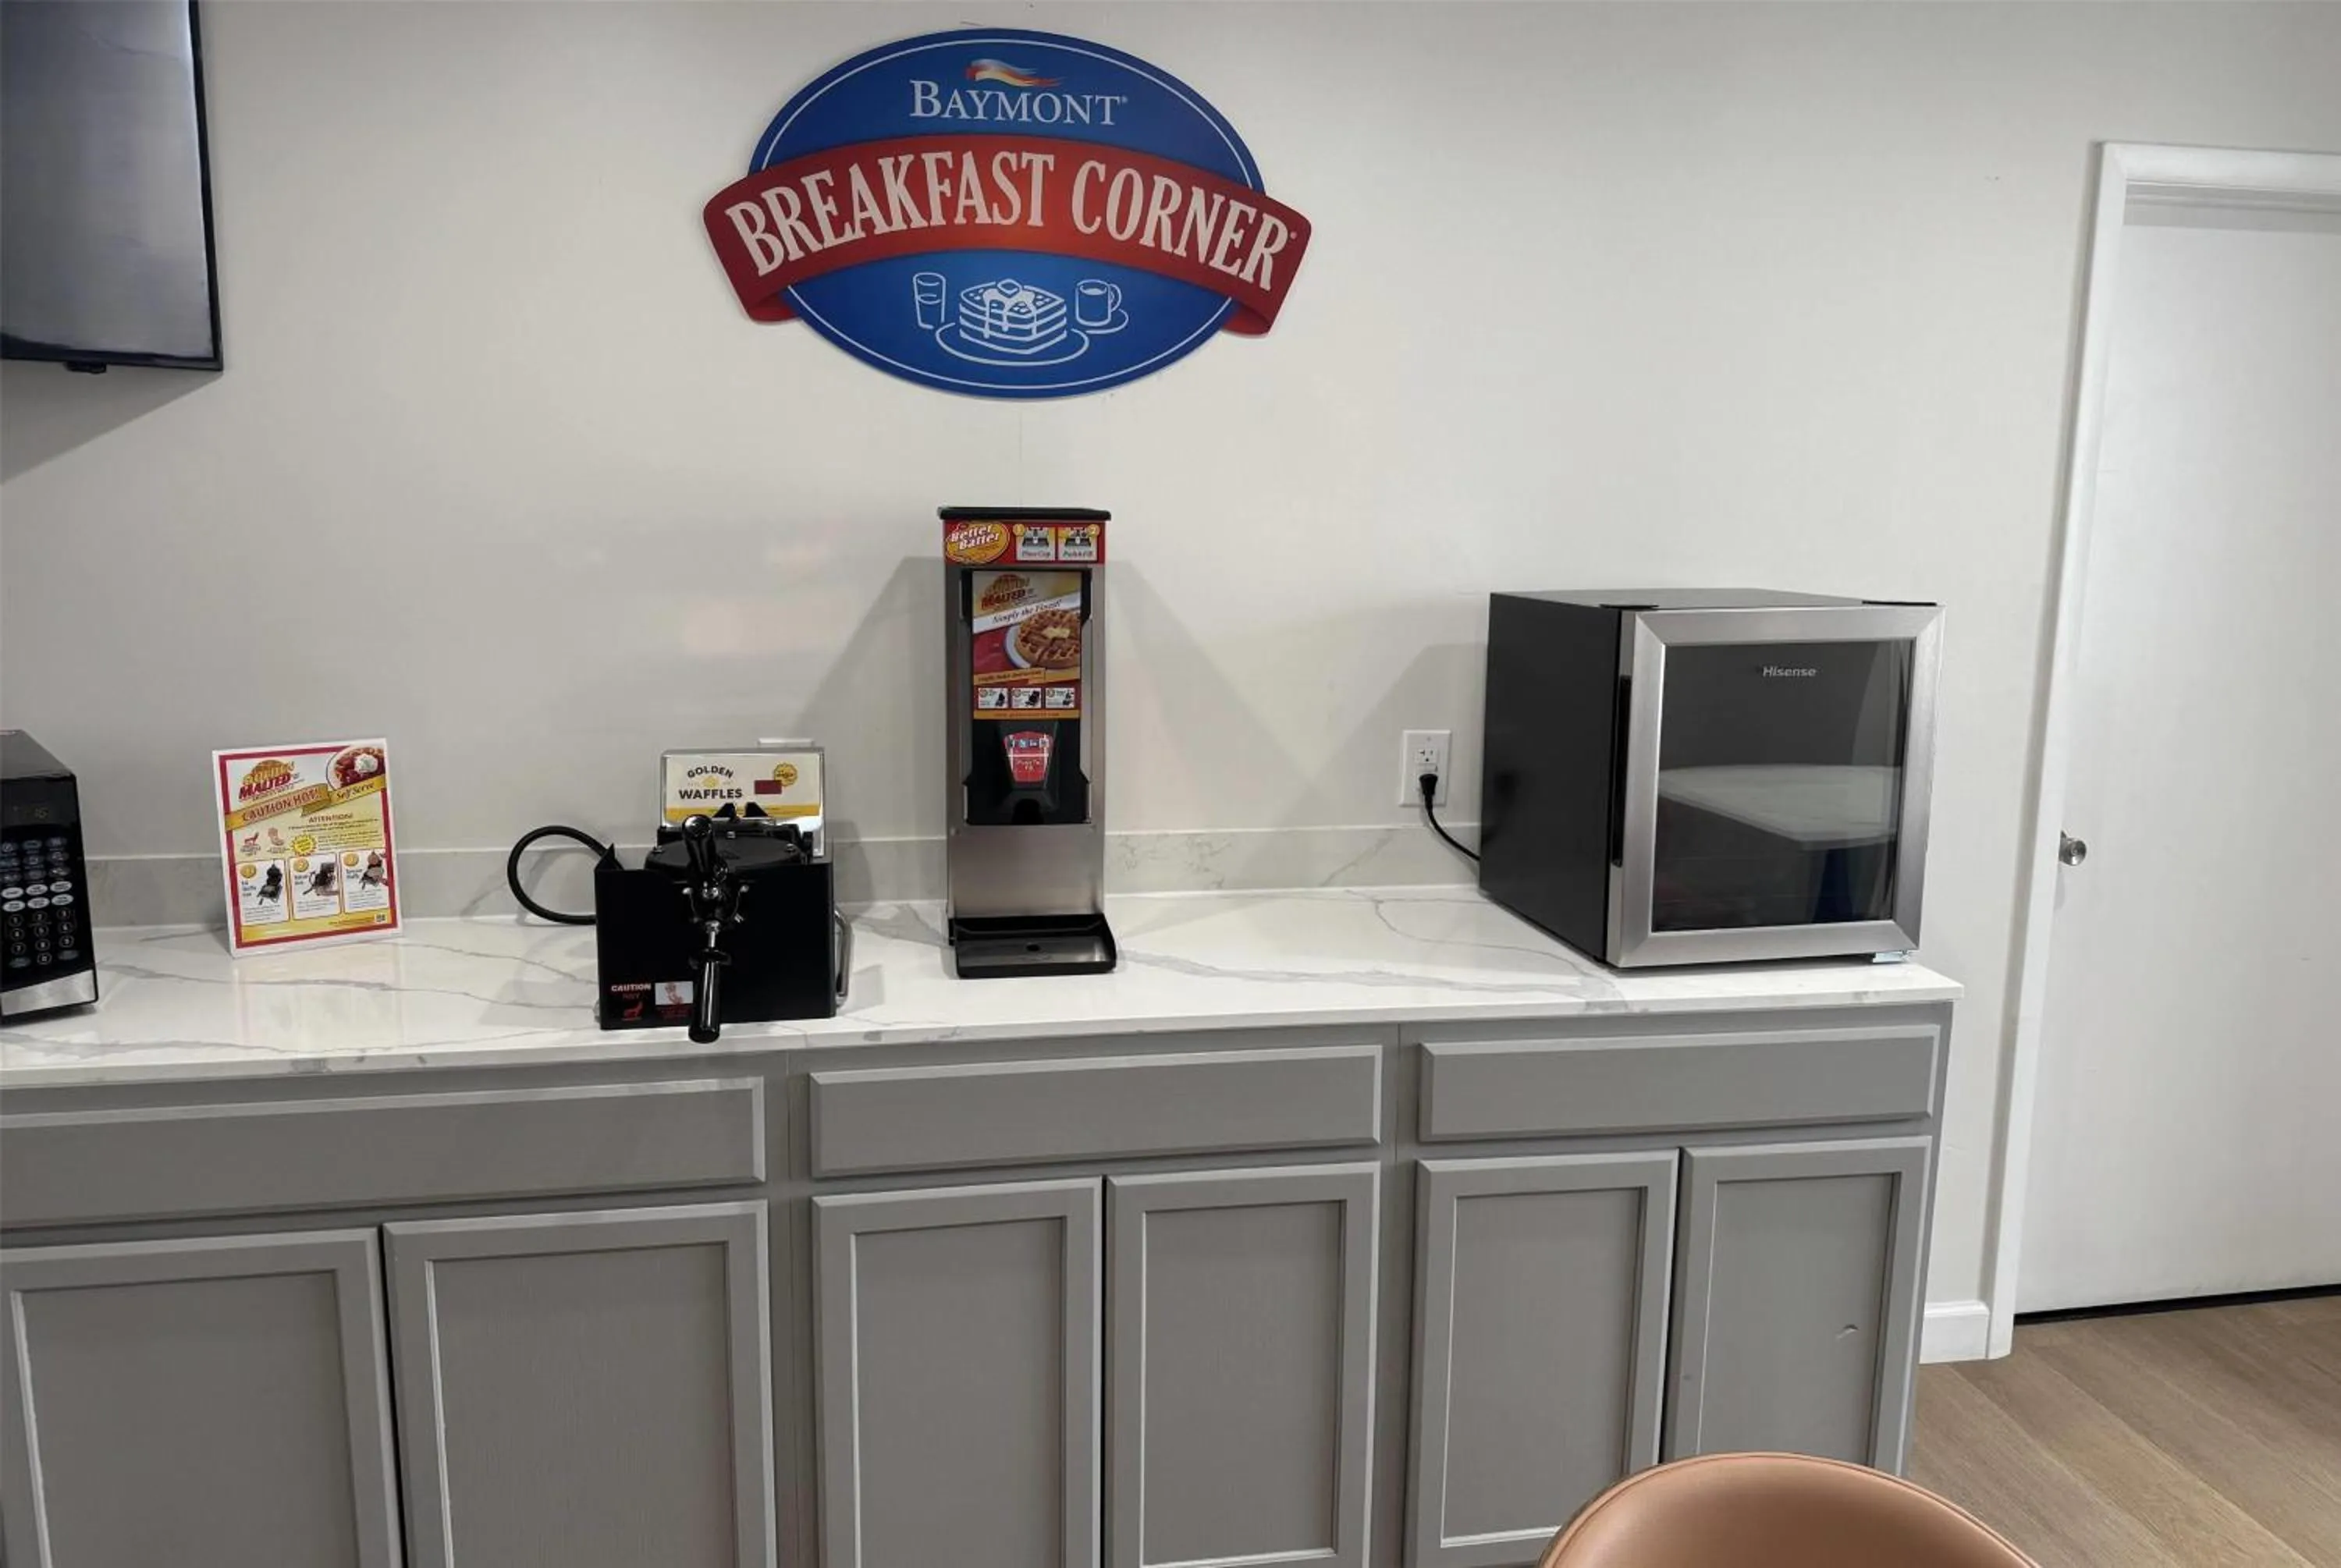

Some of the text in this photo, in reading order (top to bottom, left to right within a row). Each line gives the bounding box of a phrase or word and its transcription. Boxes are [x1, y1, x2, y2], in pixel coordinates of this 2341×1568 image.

[908, 79, 1121, 126] BAYMONT
[725, 149, 1290, 292] BREAKFAST CORNER
[1762, 665, 1817, 677] Hisense
[687, 764, 734, 779] GOLDEN
[237, 771, 291, 800] MALTED
[678, 788, 743, 800] WAFFLES
[242, 799, 292, 821] CAUTION
[611, 983, 652, 992] CAUTION
